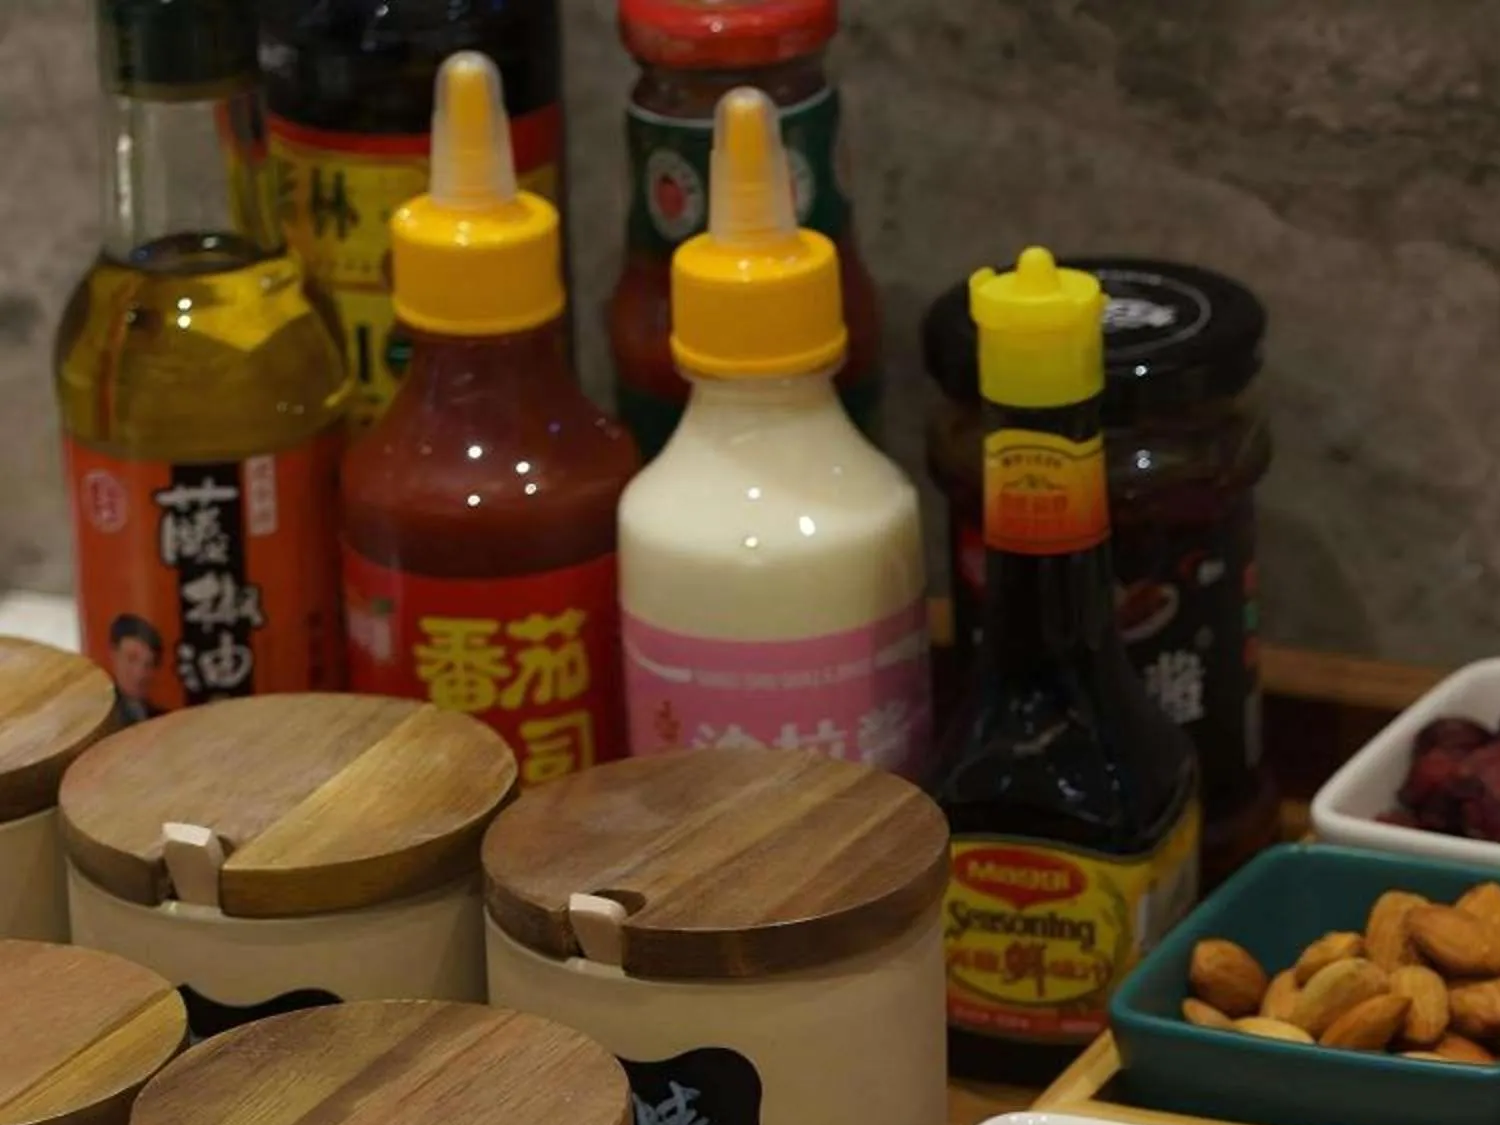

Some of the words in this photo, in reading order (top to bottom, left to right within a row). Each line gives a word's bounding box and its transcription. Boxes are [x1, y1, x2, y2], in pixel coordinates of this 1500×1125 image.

[413, 608, 588, 712] 番茄
[520, 711, 594, 782] 司
[943, 901, 1096, 952] Seasoning
